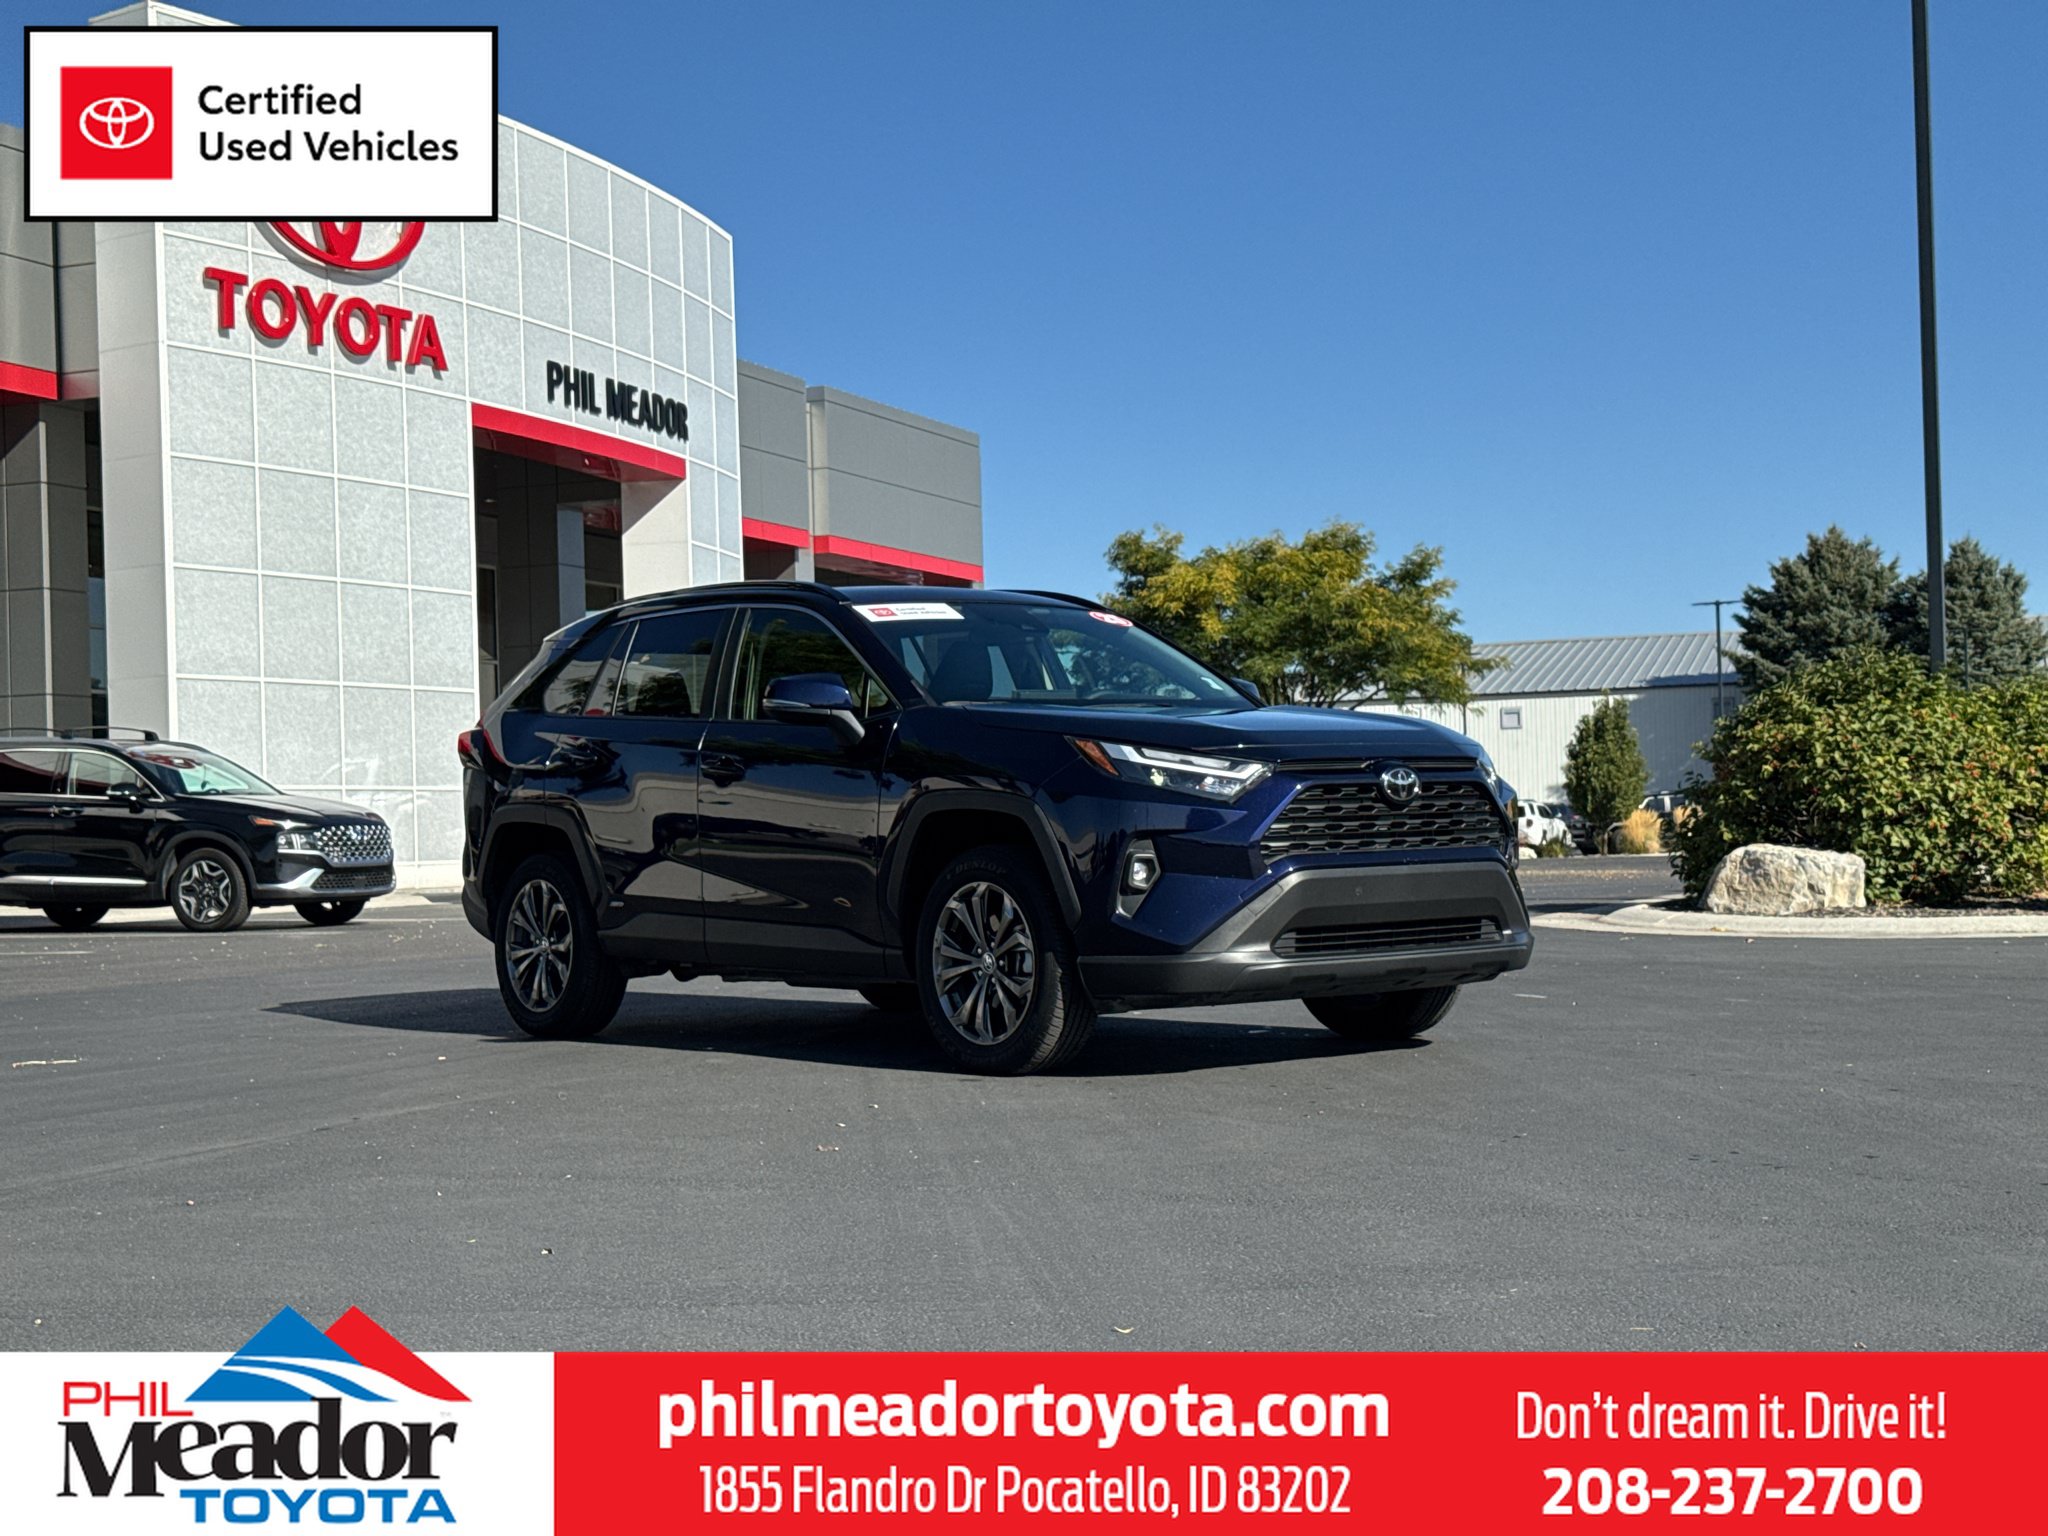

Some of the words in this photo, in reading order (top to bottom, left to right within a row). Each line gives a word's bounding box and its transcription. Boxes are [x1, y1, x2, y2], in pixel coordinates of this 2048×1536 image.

[203, 267, 448, 371] TOYOTA
[547, 360, 602, 416] PHIL
[605, 377, 690, 443] MEADOR
